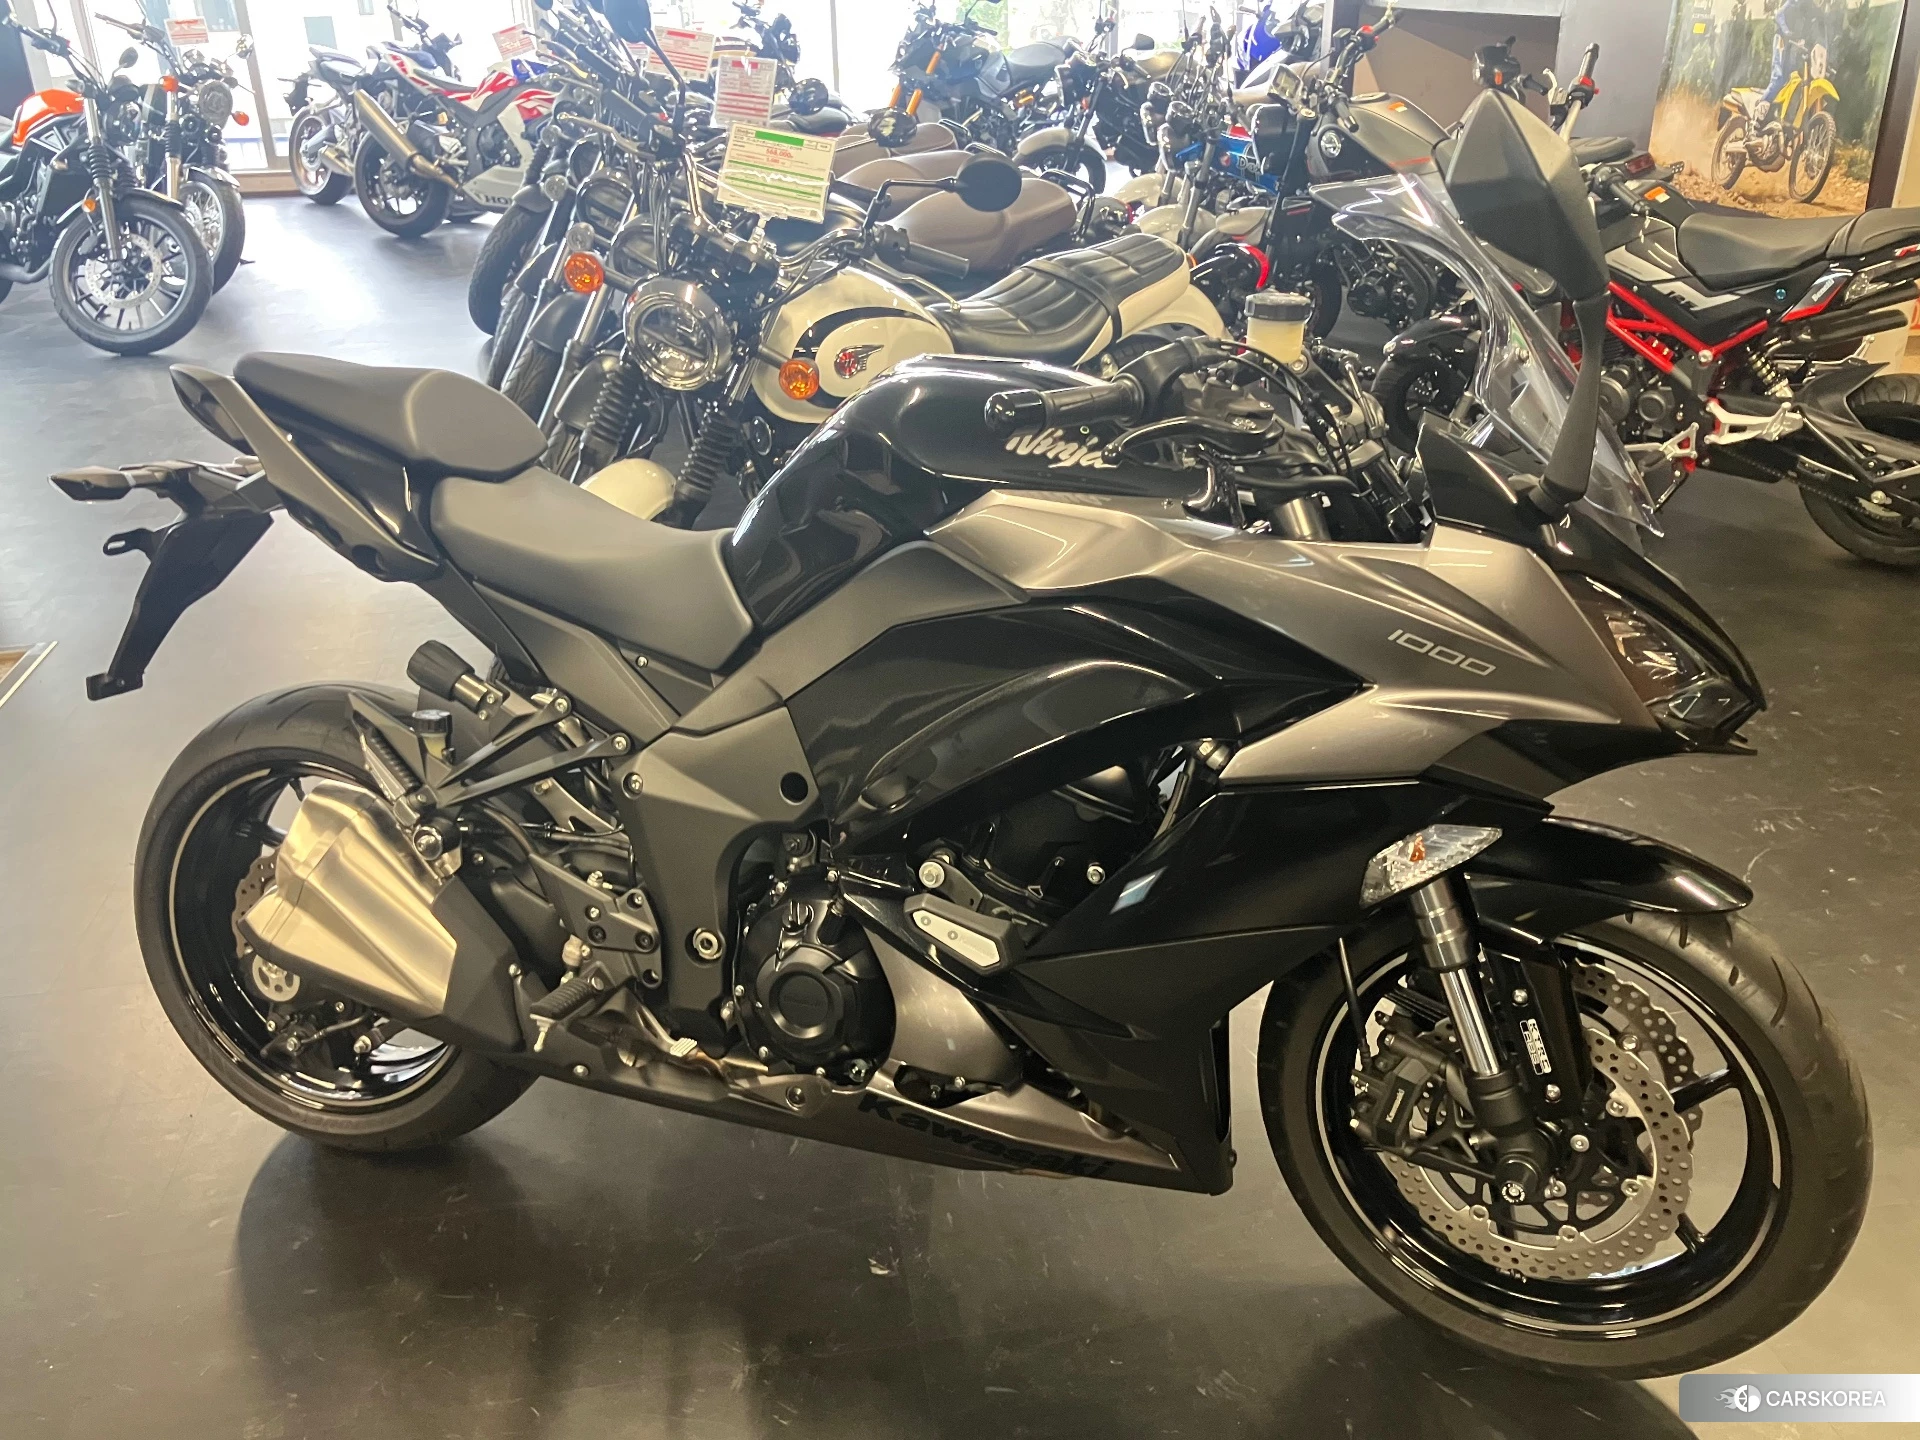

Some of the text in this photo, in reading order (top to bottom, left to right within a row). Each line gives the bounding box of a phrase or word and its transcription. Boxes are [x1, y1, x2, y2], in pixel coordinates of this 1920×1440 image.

[1005, 427, 1118, 469] Ninja
[1387, 629, 1497, 676] 1000
[1529, 1022, 1550, 1070] KTRC
[857, 1092, 1112, 1177] Kawasaki
